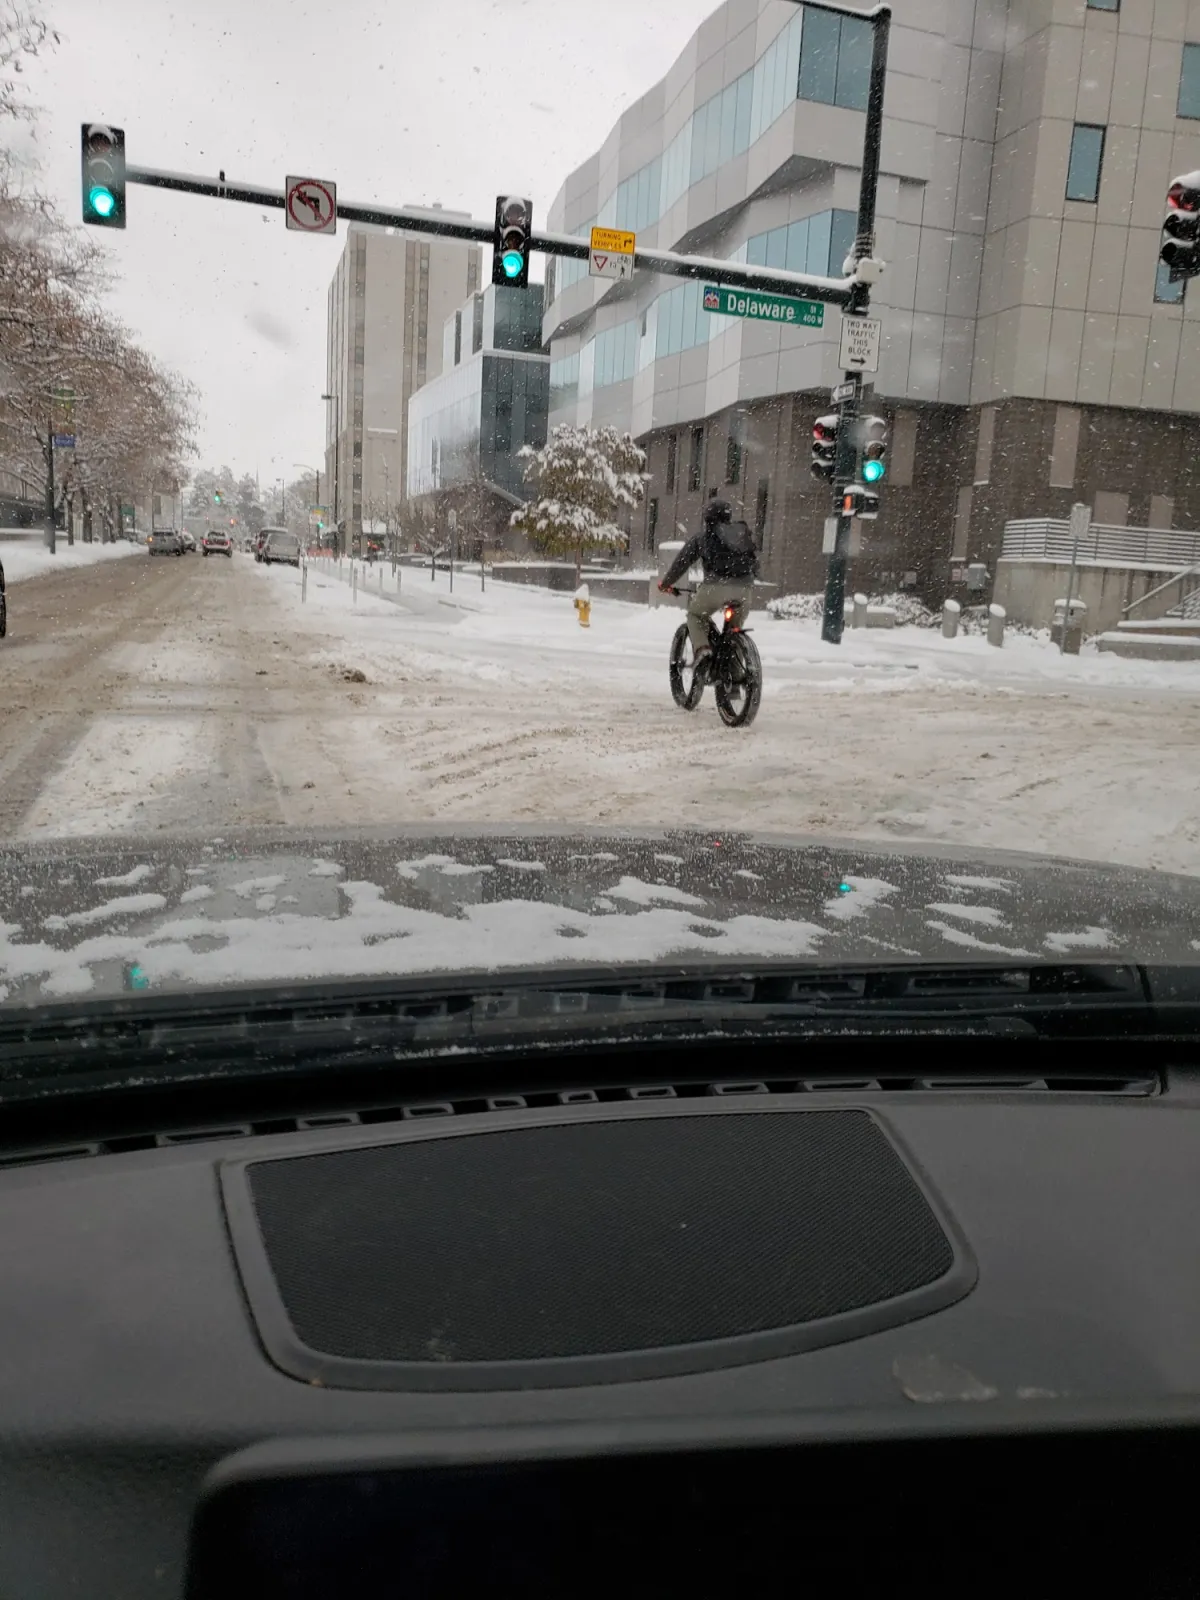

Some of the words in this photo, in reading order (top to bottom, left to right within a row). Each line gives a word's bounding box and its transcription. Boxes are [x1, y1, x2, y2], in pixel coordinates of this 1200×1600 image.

[597, 231, 621, 240] TURNING
[594, 240, 621, 249] VEHICLES
[727, 293, 795, 319] Delaware
[803, 314, 815, 324] 400
[848, 320, 860, 329] TWO
[863, 323, 877, 331] WAY
[848, 329, 876, 339] TRAFFIC
[854, 339, 868, 347] THIS
[848, 347, 871, 356] BLOCK
